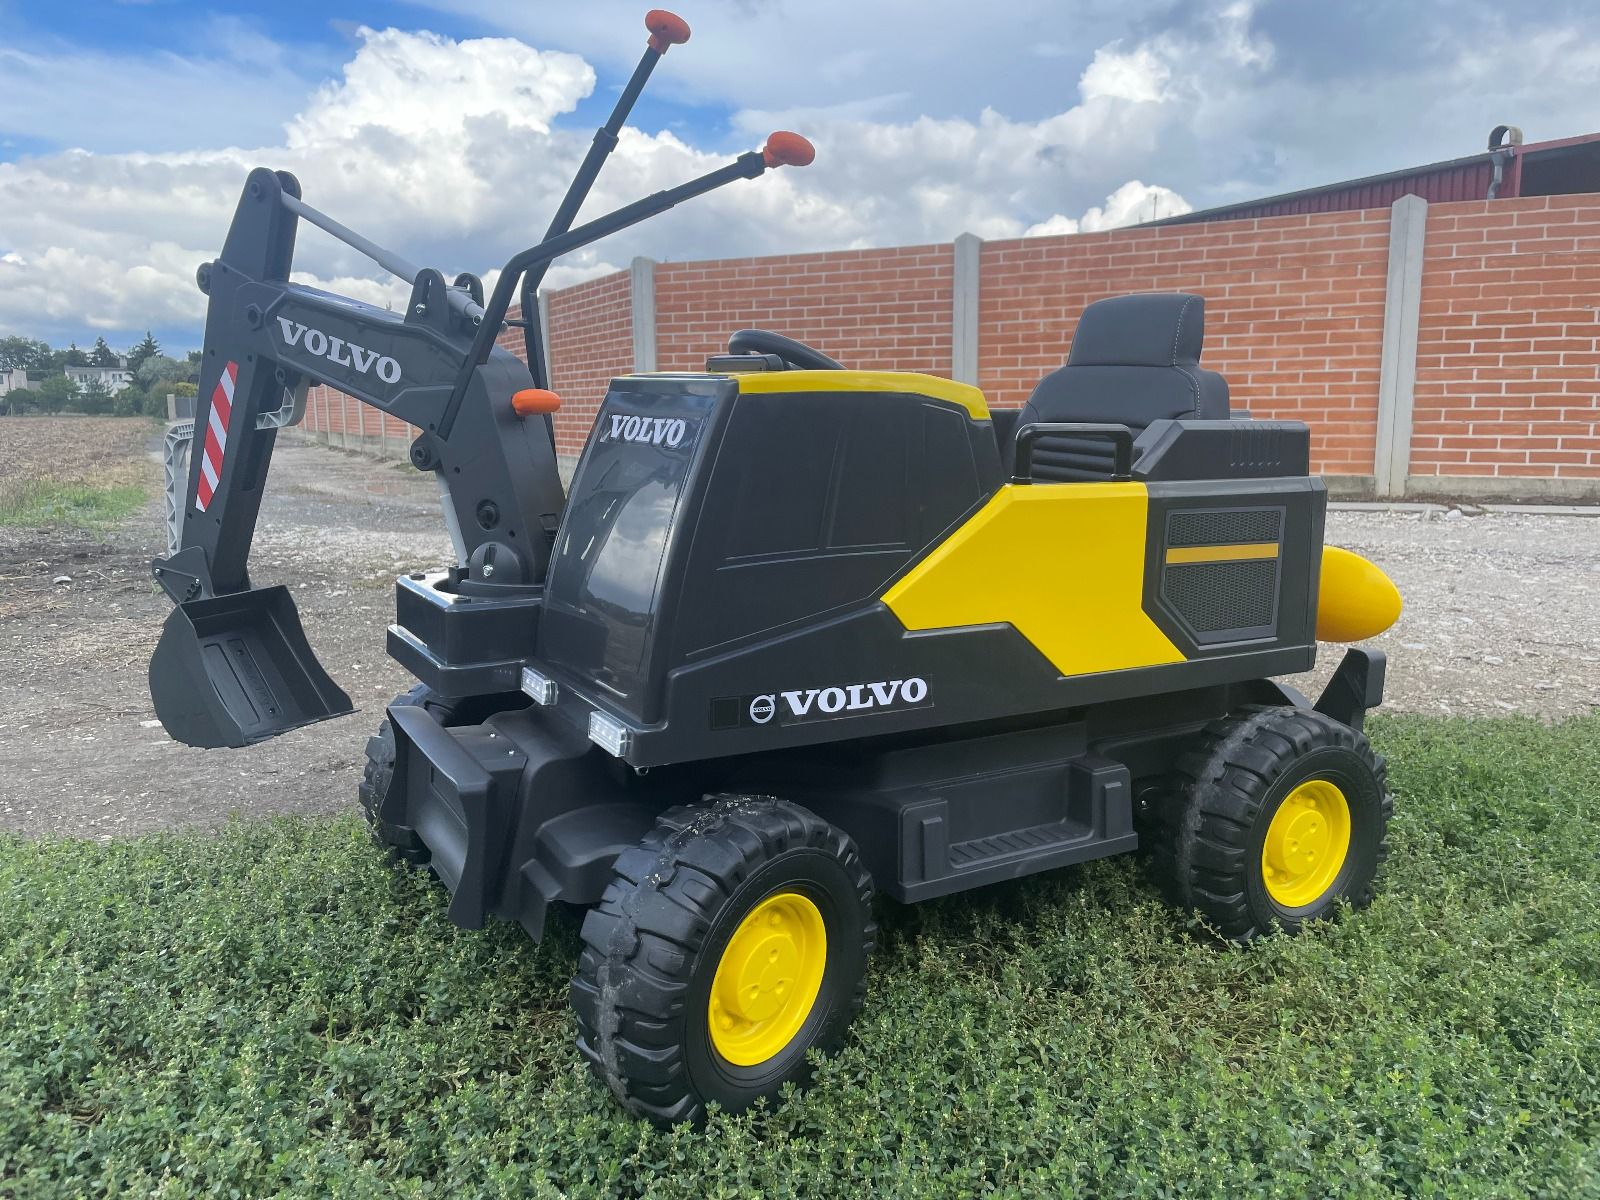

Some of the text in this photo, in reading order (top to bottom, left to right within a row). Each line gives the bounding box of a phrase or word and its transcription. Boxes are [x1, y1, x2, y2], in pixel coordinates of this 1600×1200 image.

[276, 316, 402, 384] VOLVO
[610, 414, 686, 446] VOLVO
[781, 677, 928, 716] VOLVO
